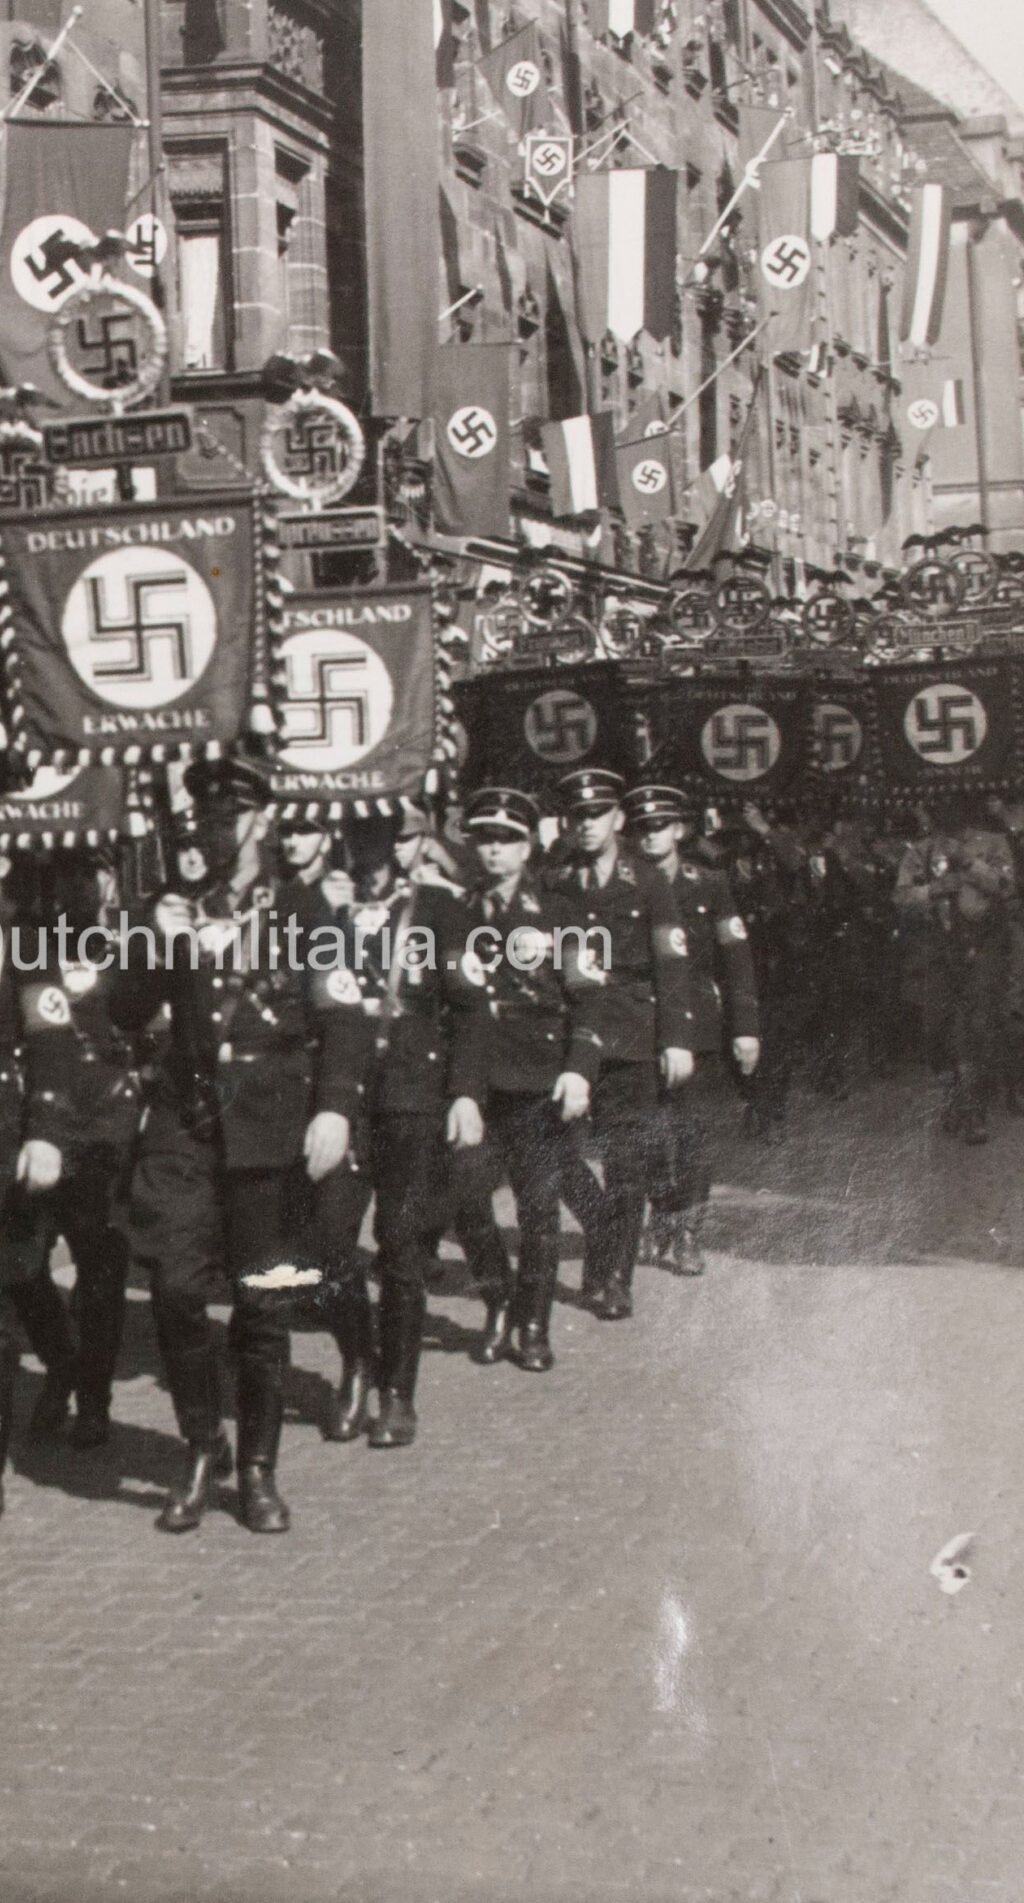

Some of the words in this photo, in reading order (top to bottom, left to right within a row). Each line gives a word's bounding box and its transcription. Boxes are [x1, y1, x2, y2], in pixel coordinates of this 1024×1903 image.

[27, 516, 236, 552] DEUTSCHLAND
[82, 709, 211, 735] ERWACHE
[269, 770, 385, 791] ERWACHE
